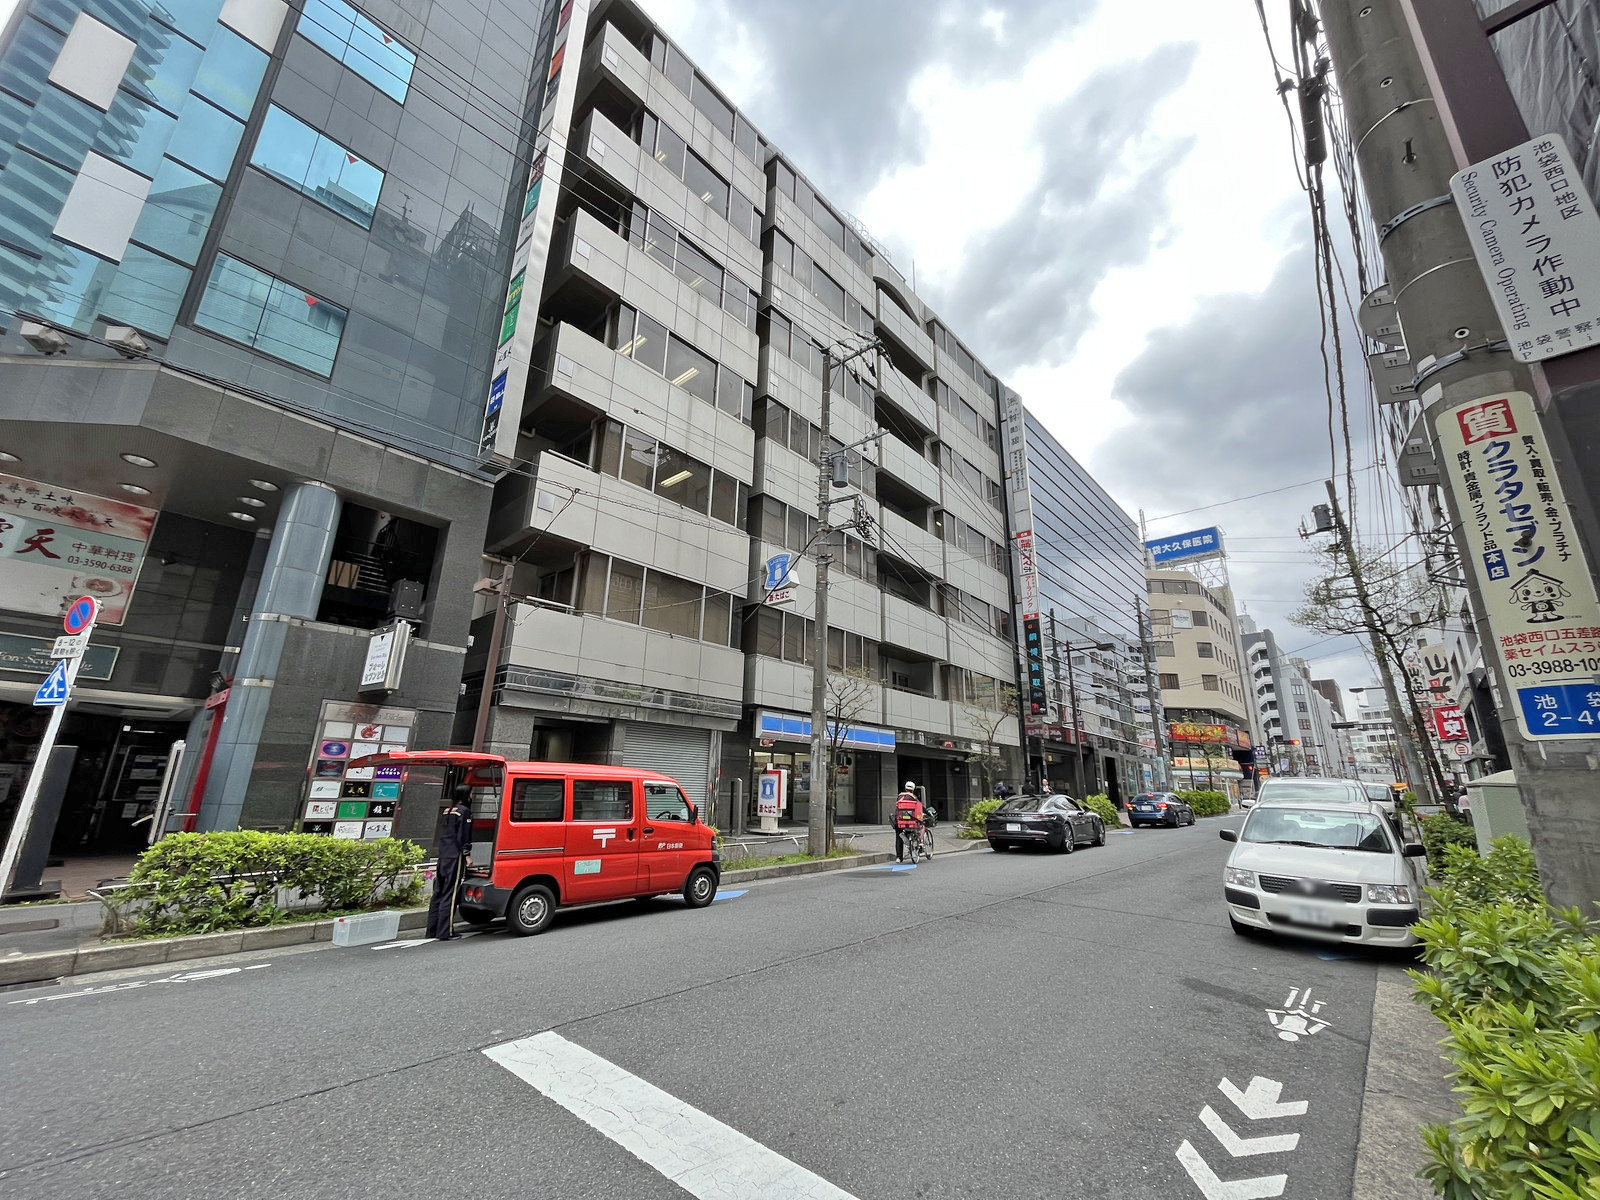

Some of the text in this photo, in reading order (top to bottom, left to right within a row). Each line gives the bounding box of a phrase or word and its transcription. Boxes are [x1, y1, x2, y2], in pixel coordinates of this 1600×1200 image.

[1532, 140, 1584, 221] 池袋西口地区
[1461, 170, 1531, 331] Security Camera Operating
[1491, 154, 1581, 318] 防犯カメラ作動中
[1460, 401, 1515, 443] 質
[1456, 449, 1498, 551] 時計・貴金属・ブランド品
[1482, 439, 1546, 569] クラタセブン
[71, 541, 136, 564] 中華料理
[1146, 533, 1214, 556] 袋大久保医院
[67, 554, 133, 575] 03-3590-6388
[1485, 551, 1506, 579] 本店
[1499, 626, 1600, 647] 池袋西口五差路
[1541, 709, 1600, 727] 2-4
